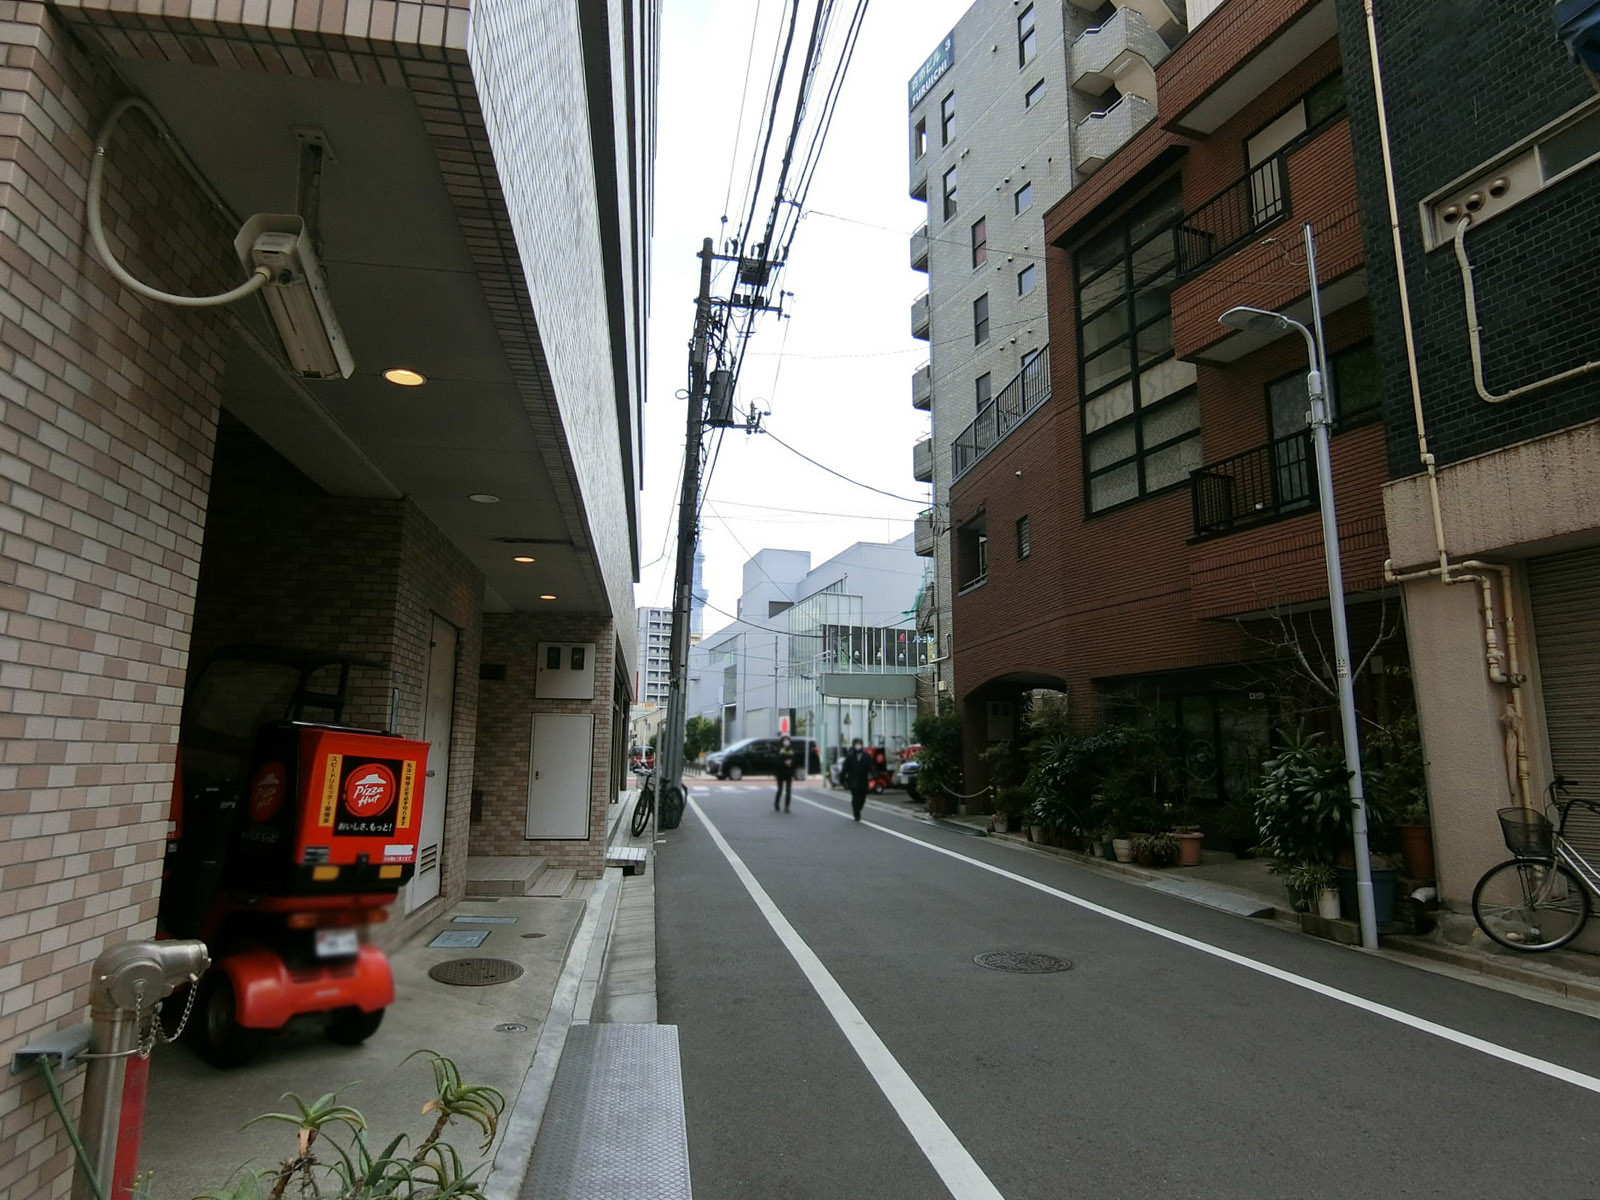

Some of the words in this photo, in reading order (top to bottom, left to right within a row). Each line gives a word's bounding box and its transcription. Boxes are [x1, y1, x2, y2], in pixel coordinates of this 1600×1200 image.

[912, 59, 947, 105] FURUICHI
[353, 784, 385, 799] Pizza
[358, 795, 382, 808] Hut
